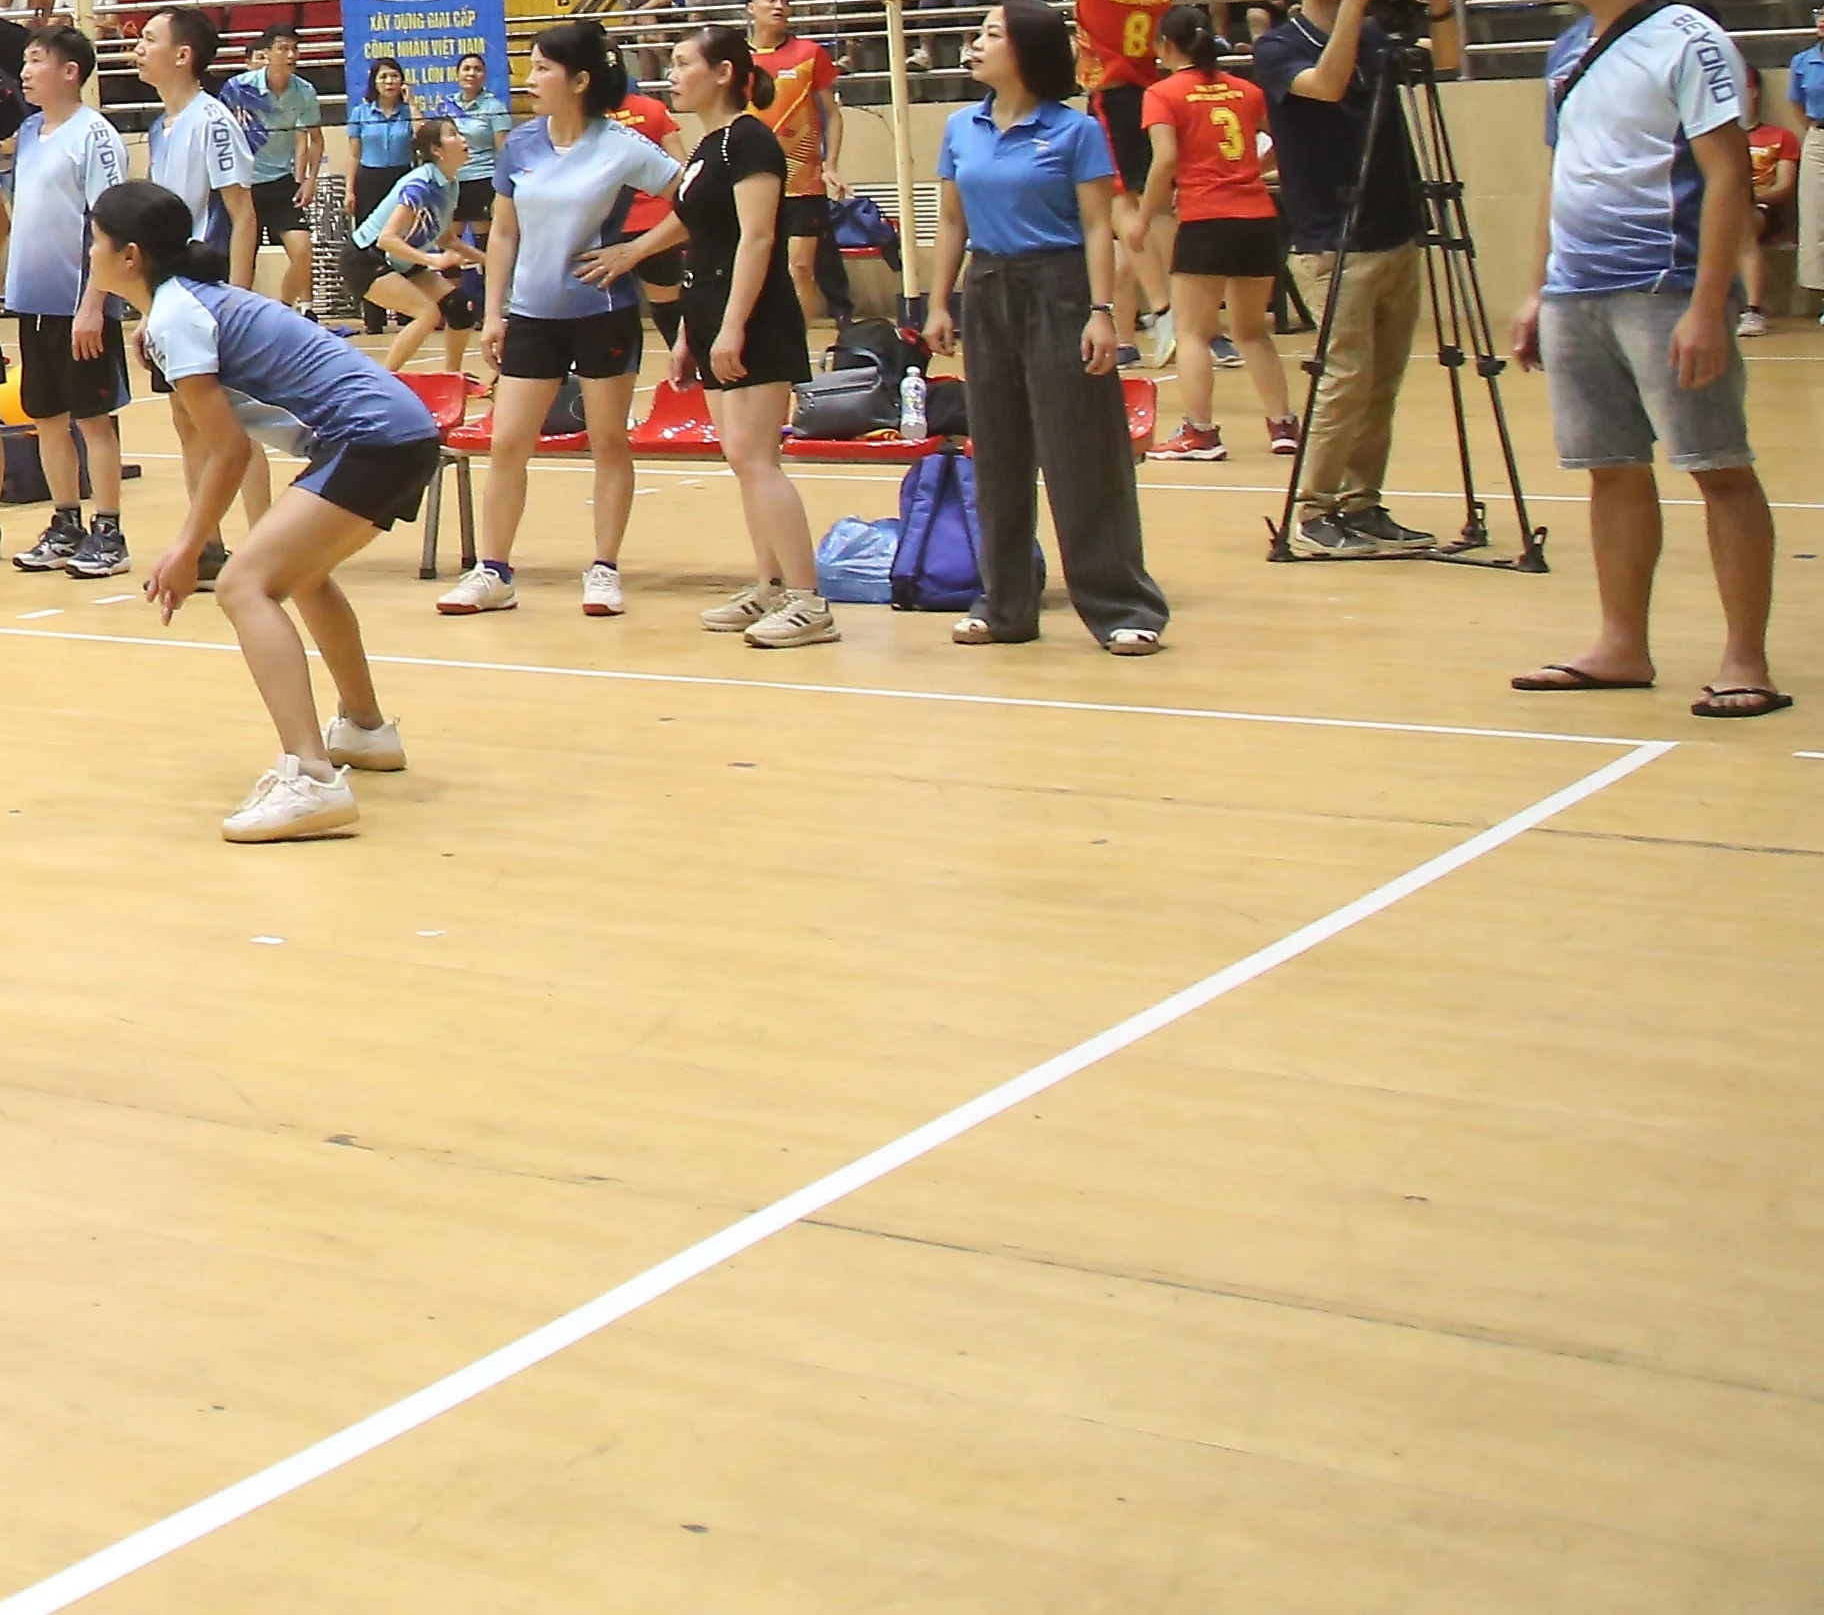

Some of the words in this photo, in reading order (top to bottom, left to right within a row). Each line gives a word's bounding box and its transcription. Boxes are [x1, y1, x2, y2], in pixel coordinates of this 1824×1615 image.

[370, 10, 390, 31] XÂY
[1123, 10, 1152, 58] 8
[364, 39, 395, 59] CÔNG
[458, 37, 486, 56] NAM
[1671, 13, 1737, 103] BEYOND
[89, 120, 124, 184] BEYON
[1209, 106, 1246, 161] 3
